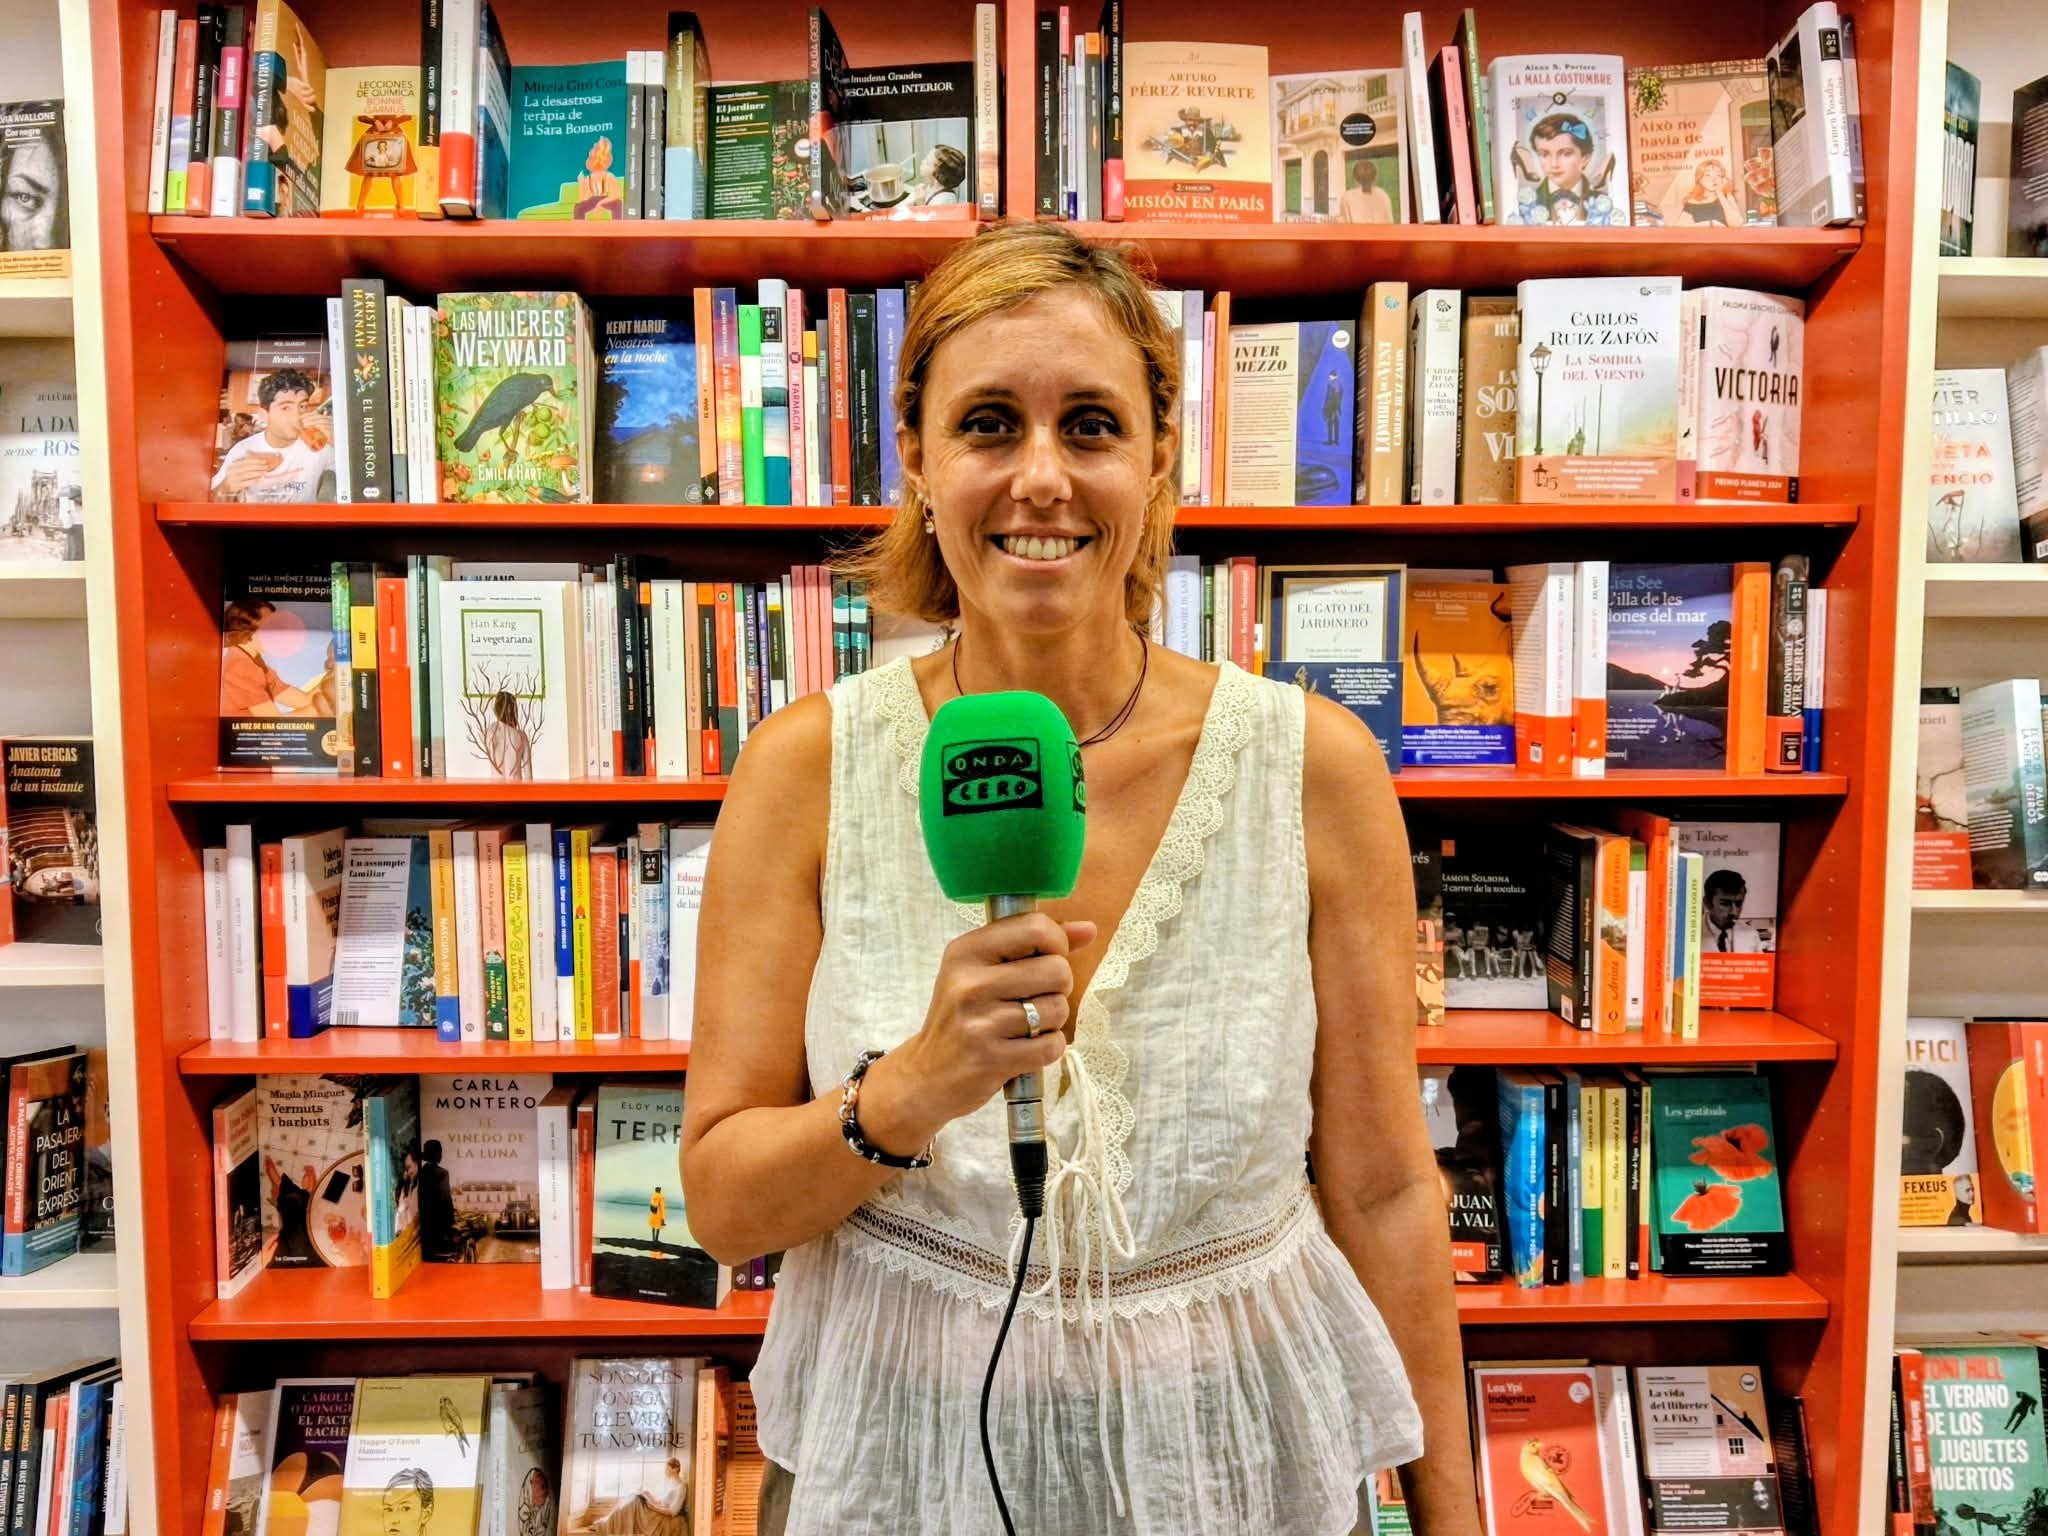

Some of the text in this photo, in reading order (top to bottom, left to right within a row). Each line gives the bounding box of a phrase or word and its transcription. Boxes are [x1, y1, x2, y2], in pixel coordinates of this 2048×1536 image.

[887, 70, 923, 82] Grandes
[1168, 72, 1217, 83] ARTURO
[1508, 72, 1613, 86] LA MALA COSTUMBRE
[359, 80, 414, 90] LECCIONES
[901, 80, 954, 95] INTERIOR
[1129, 82, 1256, 101] PÉREZ REVERTE
[356, 89, 369, 98] DE
[524, 94, 603, 107] La desastrosa
[523, 108, 583, 123] teràpia de
[716, 101, 766, 115] El jardiner
[14, 111, 56, 122] AVALLONE
[721, 114, 735, 123] la
[736, 112, 754, 122] mort
[523, 121, 613, 136] la Sara Bonsom
[1639, 117, 1697, 132] Això no
[1640, 132, 1703, 147] havia de
[1641, 145, 1725, 165] passar avui
[1124, 191, 1265, 213] MISIÓN EN PARÍS
[354, 288, 364, 348] HANNAH
[367, 291, 377, 346] KRISTIN
[452, 309, 566, 338] LAS MUJERES
[1571, 311, 1639, 327] CARLOS
[605, 319, 668, 335] KENT HARUF
[605, 336, 655, 350] Nosotros
[1551, 328, 1659, 347] RUIZ ZAFÓN
[453, 332, 567, 368] WEYWARD
[604, 350, 668, 364] en la noche
[1233, 345, 1280, 359] INTER
[1233, 359, 1288, 373] MEZZO
[1563, 352, 1643, 367] LA SOMBRA
[1562, 367, 1645, 382] DEL VIENTO
[1714, 366, 1799, 406] VICTORIA
[792, 383, 801, 431] FARMACIA
[363, 399, 377, 479] EL RUISEÑOR
[1714, 477, 1769, 489] PREMIO PLANETA
[248, 584, 303, 595] Los nombres
[1635, 575, 1663, 590] See
[1641, 590, 1683, 606] de les
[1297, 602, 1374, 614] EL GATO DEL
[1649, 607, 1708, 623] del mar
[470, 618, 517, 631] Han Kang
[1299, 616, 1369, 631] JARDINERO
[470, 634, 533, 647] La vegetariana
[8, 747, 79, 762] JAVIER CERCAS
[955, 752, 1025, 772] ONDA
[9, 779, 85, 793] de un instante
[960, 782, 1028, 802] CERO
[2024, 784, 2037, 825] DEIROS
[2034, 786, 2046, 821] PAULA
[1696, 830, 1729, 843] Talese
[1722, 847, 1750, 858] poder
[367, 858, 407, 870] assumpte
[349, 869, 387, 879] familiar
[1473, 884, 1483, 893] de
[1484, 884, 1492, 893] la
[439, 917, 448, 961] NASCUDA
[451, 1078, 520, 1092] CARLA
[270, 1087, 345, 1101] Magda Minguet
[270, 1103, 324, 1115] Vermuts
[435, 1096, 537, 1110] MONTERO
[620, 1101, 650, 1112] ELOY
[57, 1109, 70, 1126] LA
[1664, 1105, 1728, 1119] Les gratituds
[279, 1116, 330, 1128] barbuts
[507, 1132, 527, 1144] DE
[52, 1151, 71, 1170] DEL
[455, 1147, 519, 1159] LA LUNA
[41, 1167, 78, 1194] ORIENT
[1903, 1180, 1948, 1194] FEXEUS
[37, 1187, 80, 1217] EXPRESS
[1449, 1193, 1494, 1211] JUAN
[1463, 1211, 1495, 1229] VAL
[1965, 1355, 2005, 1381] HILL
[588, 1368, 684, 1385] SONSOLES
[1487, 1383, 1523, 1395] Lea Ypi
[1648, 1387, 1685, 1398] La vida
[1923, 1383, 2010, 1409] EL VERANO
[602, 1391, 668, 1407] ONEGA
[1487, 1394, 1537, 1406] Indignitat
[1650, 1400, 1710, 1411] del llibreter
[297, 1415, 313, 1426] EL
[1672, 1413, 1700, 1425] Fikry
[1926, 1411, 1985, 1436] DE LOS
[581, 1431, 688, 1449] TU NOMBRE
[1939, 1439, 2031, 1464] JUGUETES
[1932, 1466, 2015, 1492] MUERTOS
